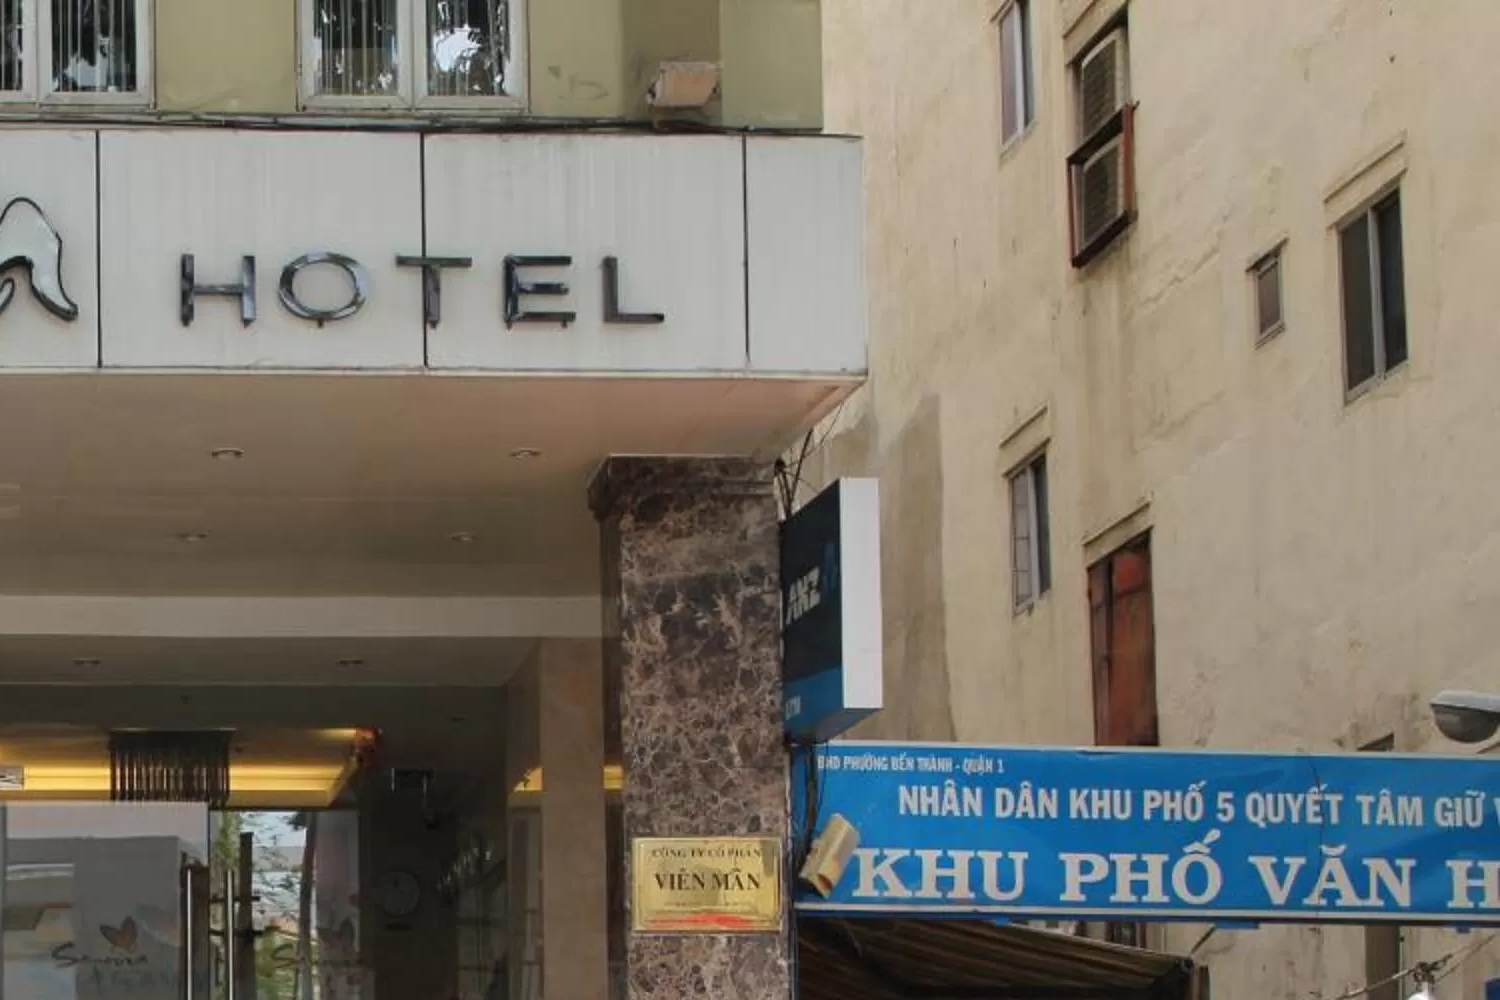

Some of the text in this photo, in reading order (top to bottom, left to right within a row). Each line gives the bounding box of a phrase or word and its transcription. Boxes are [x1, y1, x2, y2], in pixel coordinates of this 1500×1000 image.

[180, 251, 664, 328] HOTEL
[785, 566, 821, 625] ANZ
[996, 759, 1005, 773] 1
[898, 779, 983, 817] NHÂN
[994, 780, 1058, 819] DÂN
[1069, 787, 1132, 821] KHU
[1143, 780, 1206, 822] PHỐ
[1216, 790, 1235, 823] 5
[1245, 783, 1344, 829] QUYẾT
[1355, 788, 1424, 828] TÂM
[1434, 789, 1487, 828] GIỮ
[851, 847, 1029, 902] KHU
[1058, 828, 1222, 905] PHỐ
[1247, 843, 1417, 907] VĂN
